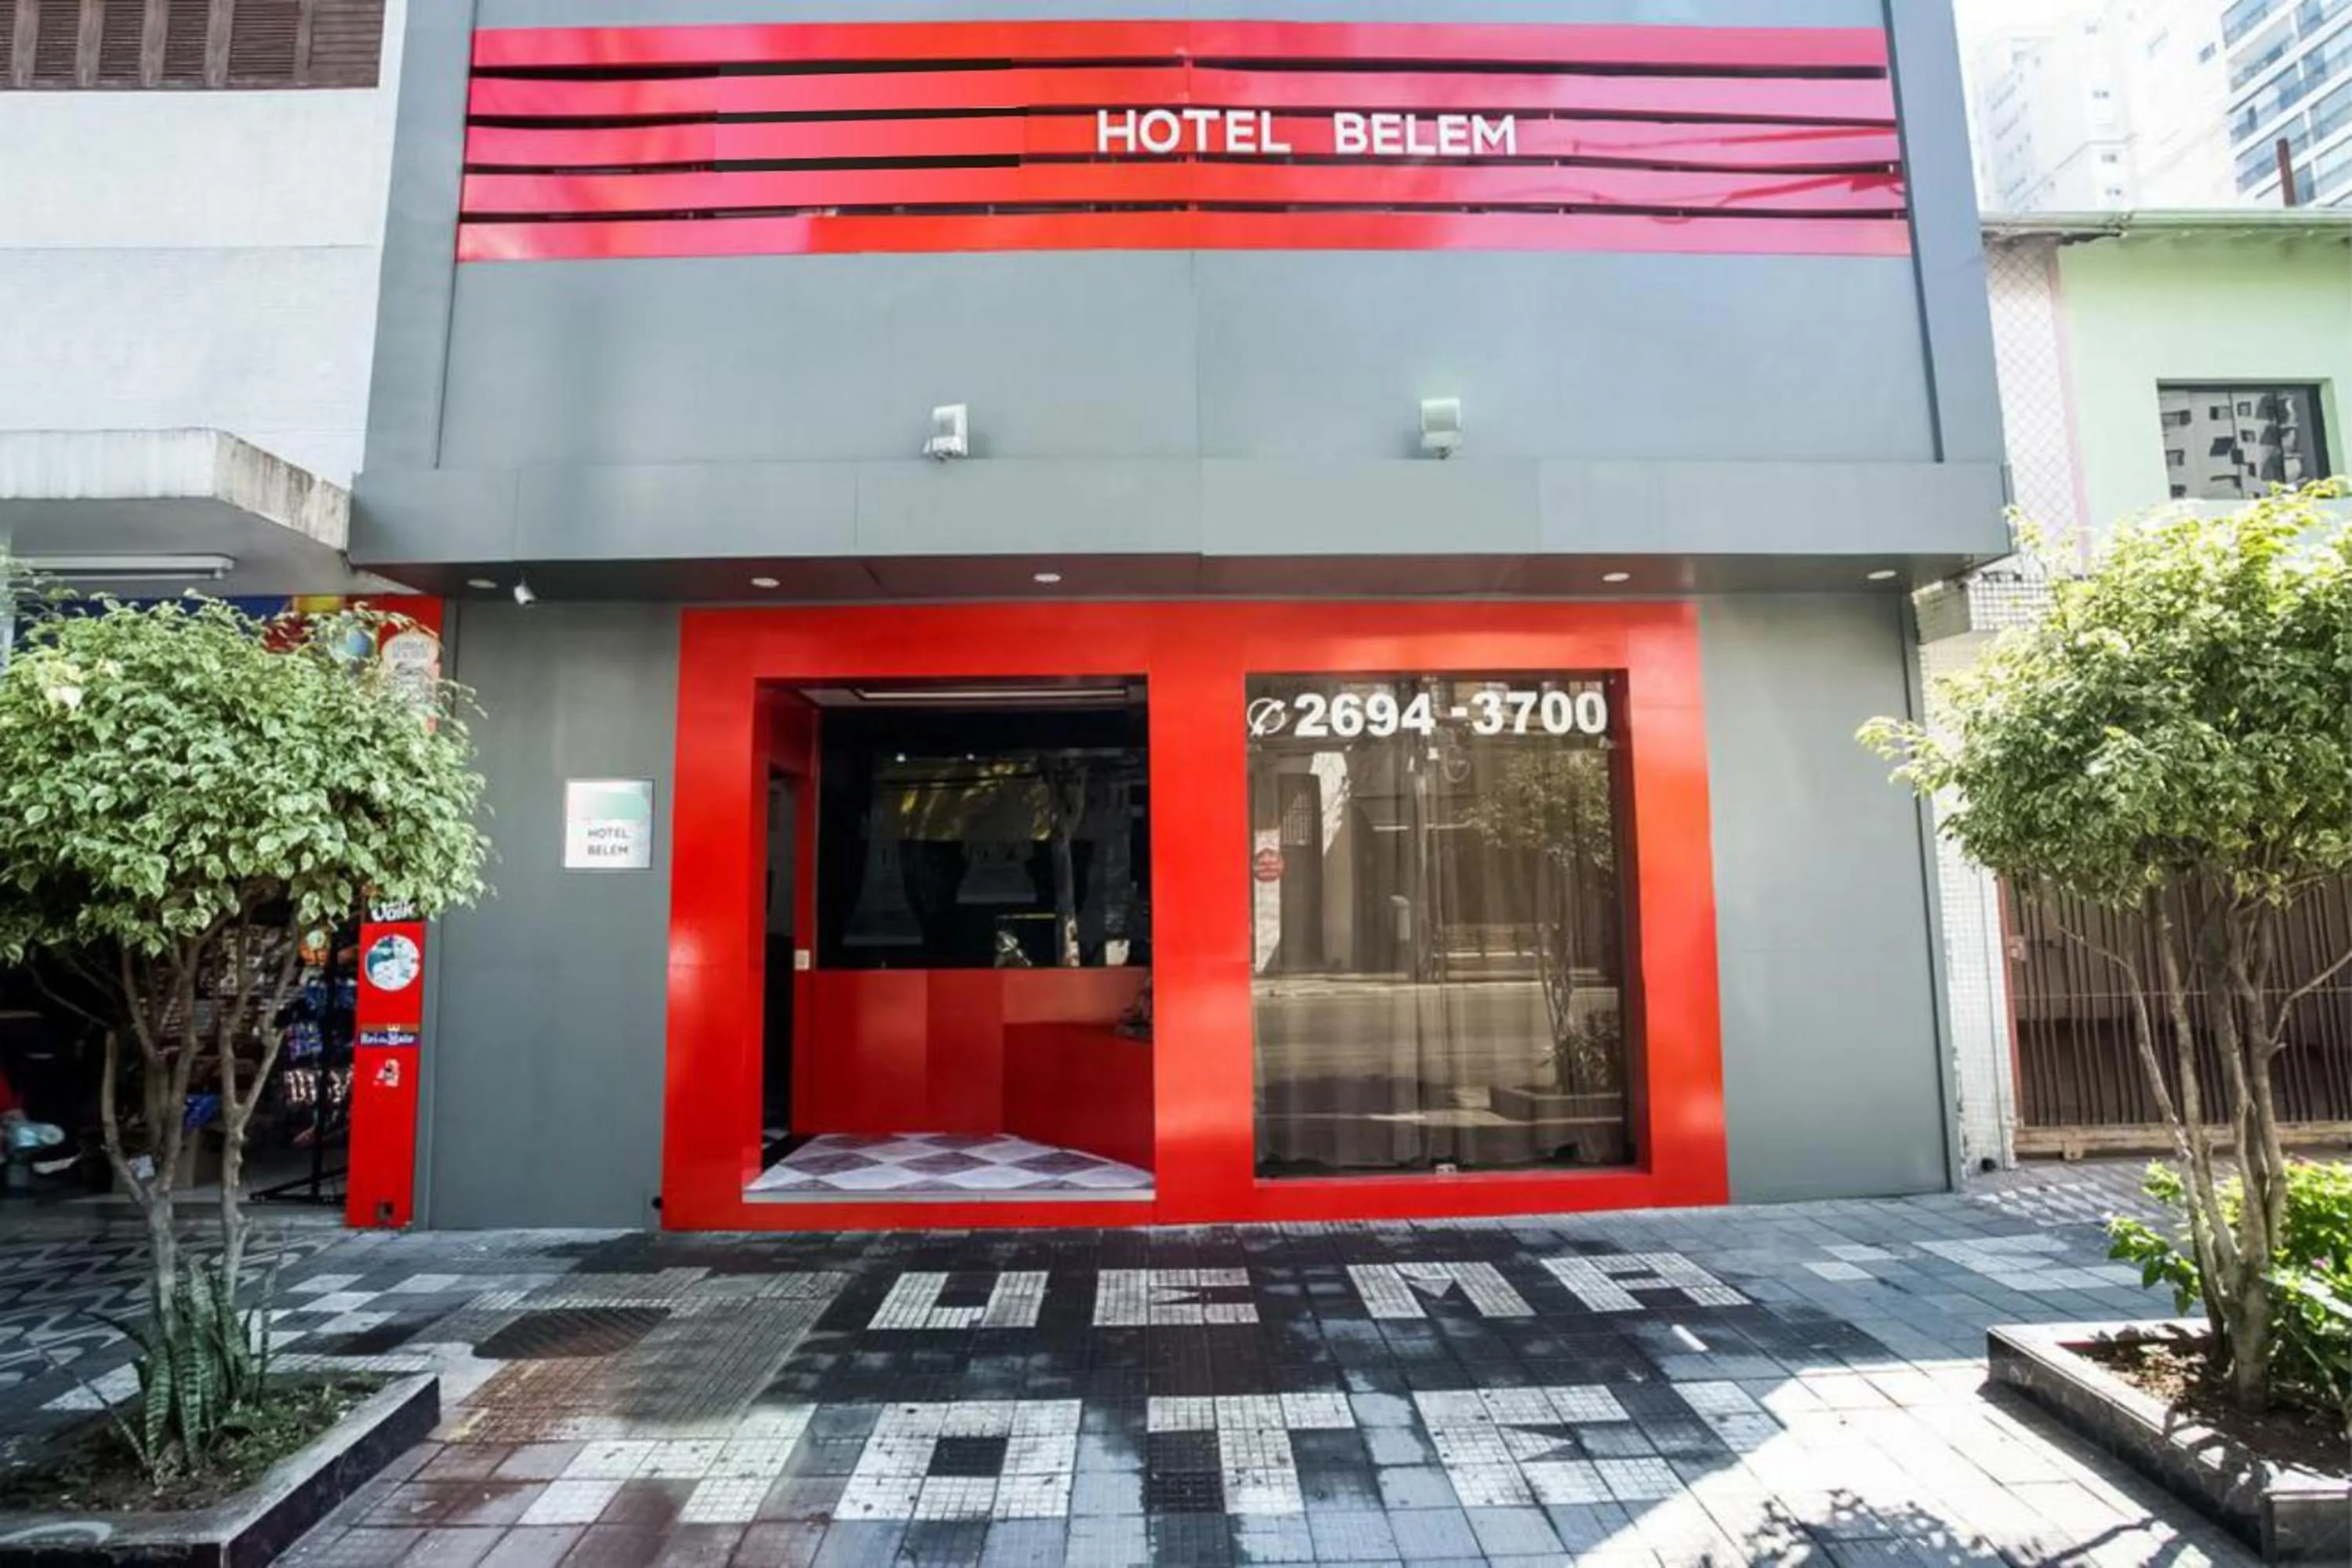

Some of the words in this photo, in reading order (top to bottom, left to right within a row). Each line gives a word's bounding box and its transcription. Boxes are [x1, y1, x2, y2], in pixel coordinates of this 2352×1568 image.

[1098, 110, 1291, 154] HOTEL
[1334, 113, 1516, 154] BELEM
[586, 828, 630, 839] HOTEL
